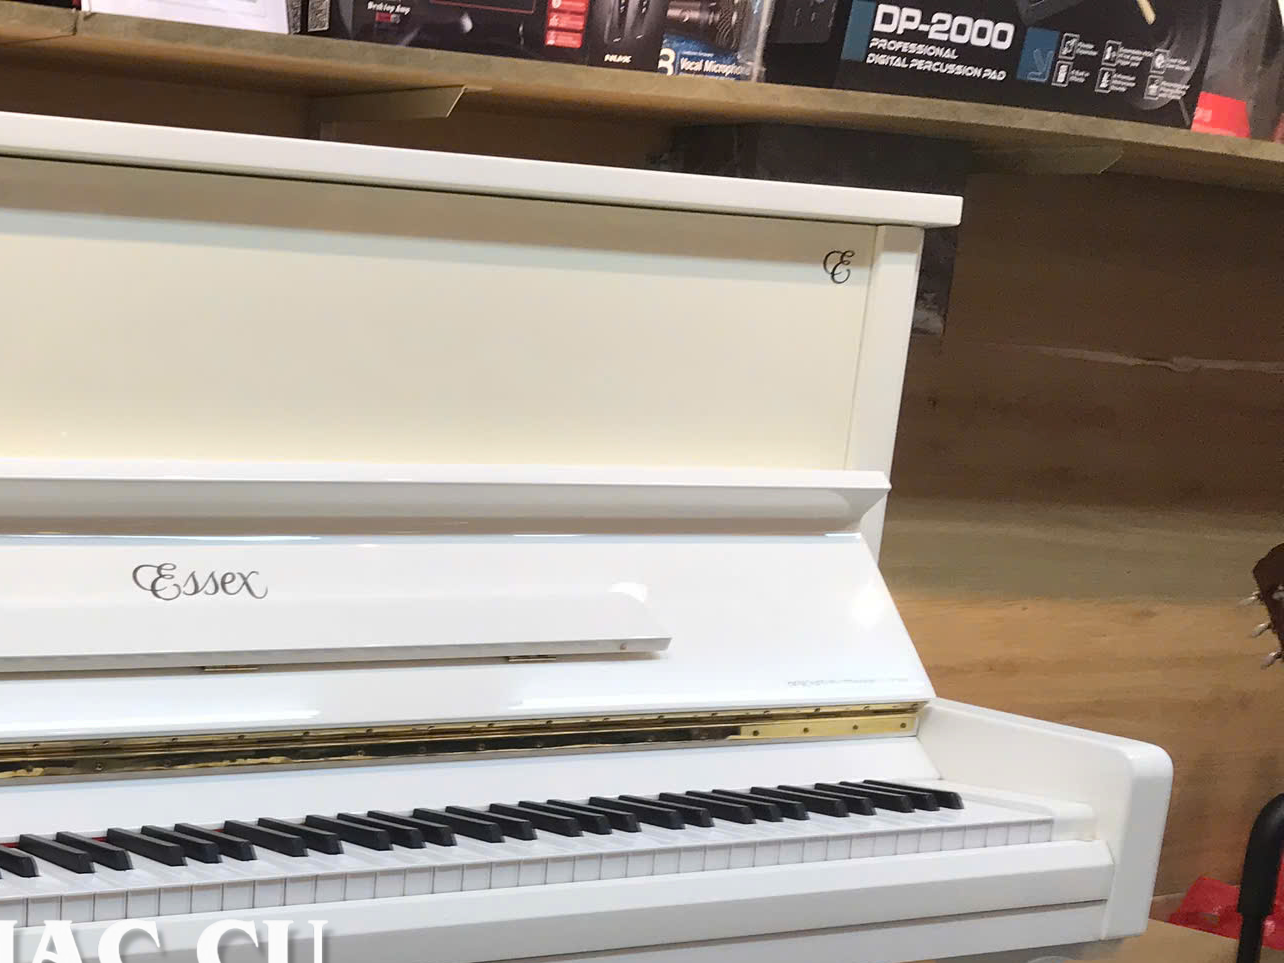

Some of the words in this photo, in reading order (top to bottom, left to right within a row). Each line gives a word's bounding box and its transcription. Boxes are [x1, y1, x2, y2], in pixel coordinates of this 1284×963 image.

[873, 3, 1015, 50] DP-2000
[868, 37, 958, 60] PROFESSIONAL
[680, 57, 703, 71] Vocal
[866, 52, 909, 69] DIGITAL
[909, 58, 983, 78] PERCUSSION
[982, 68, 1007, 81] PAD
[132, 563, 268, 601] Essex
